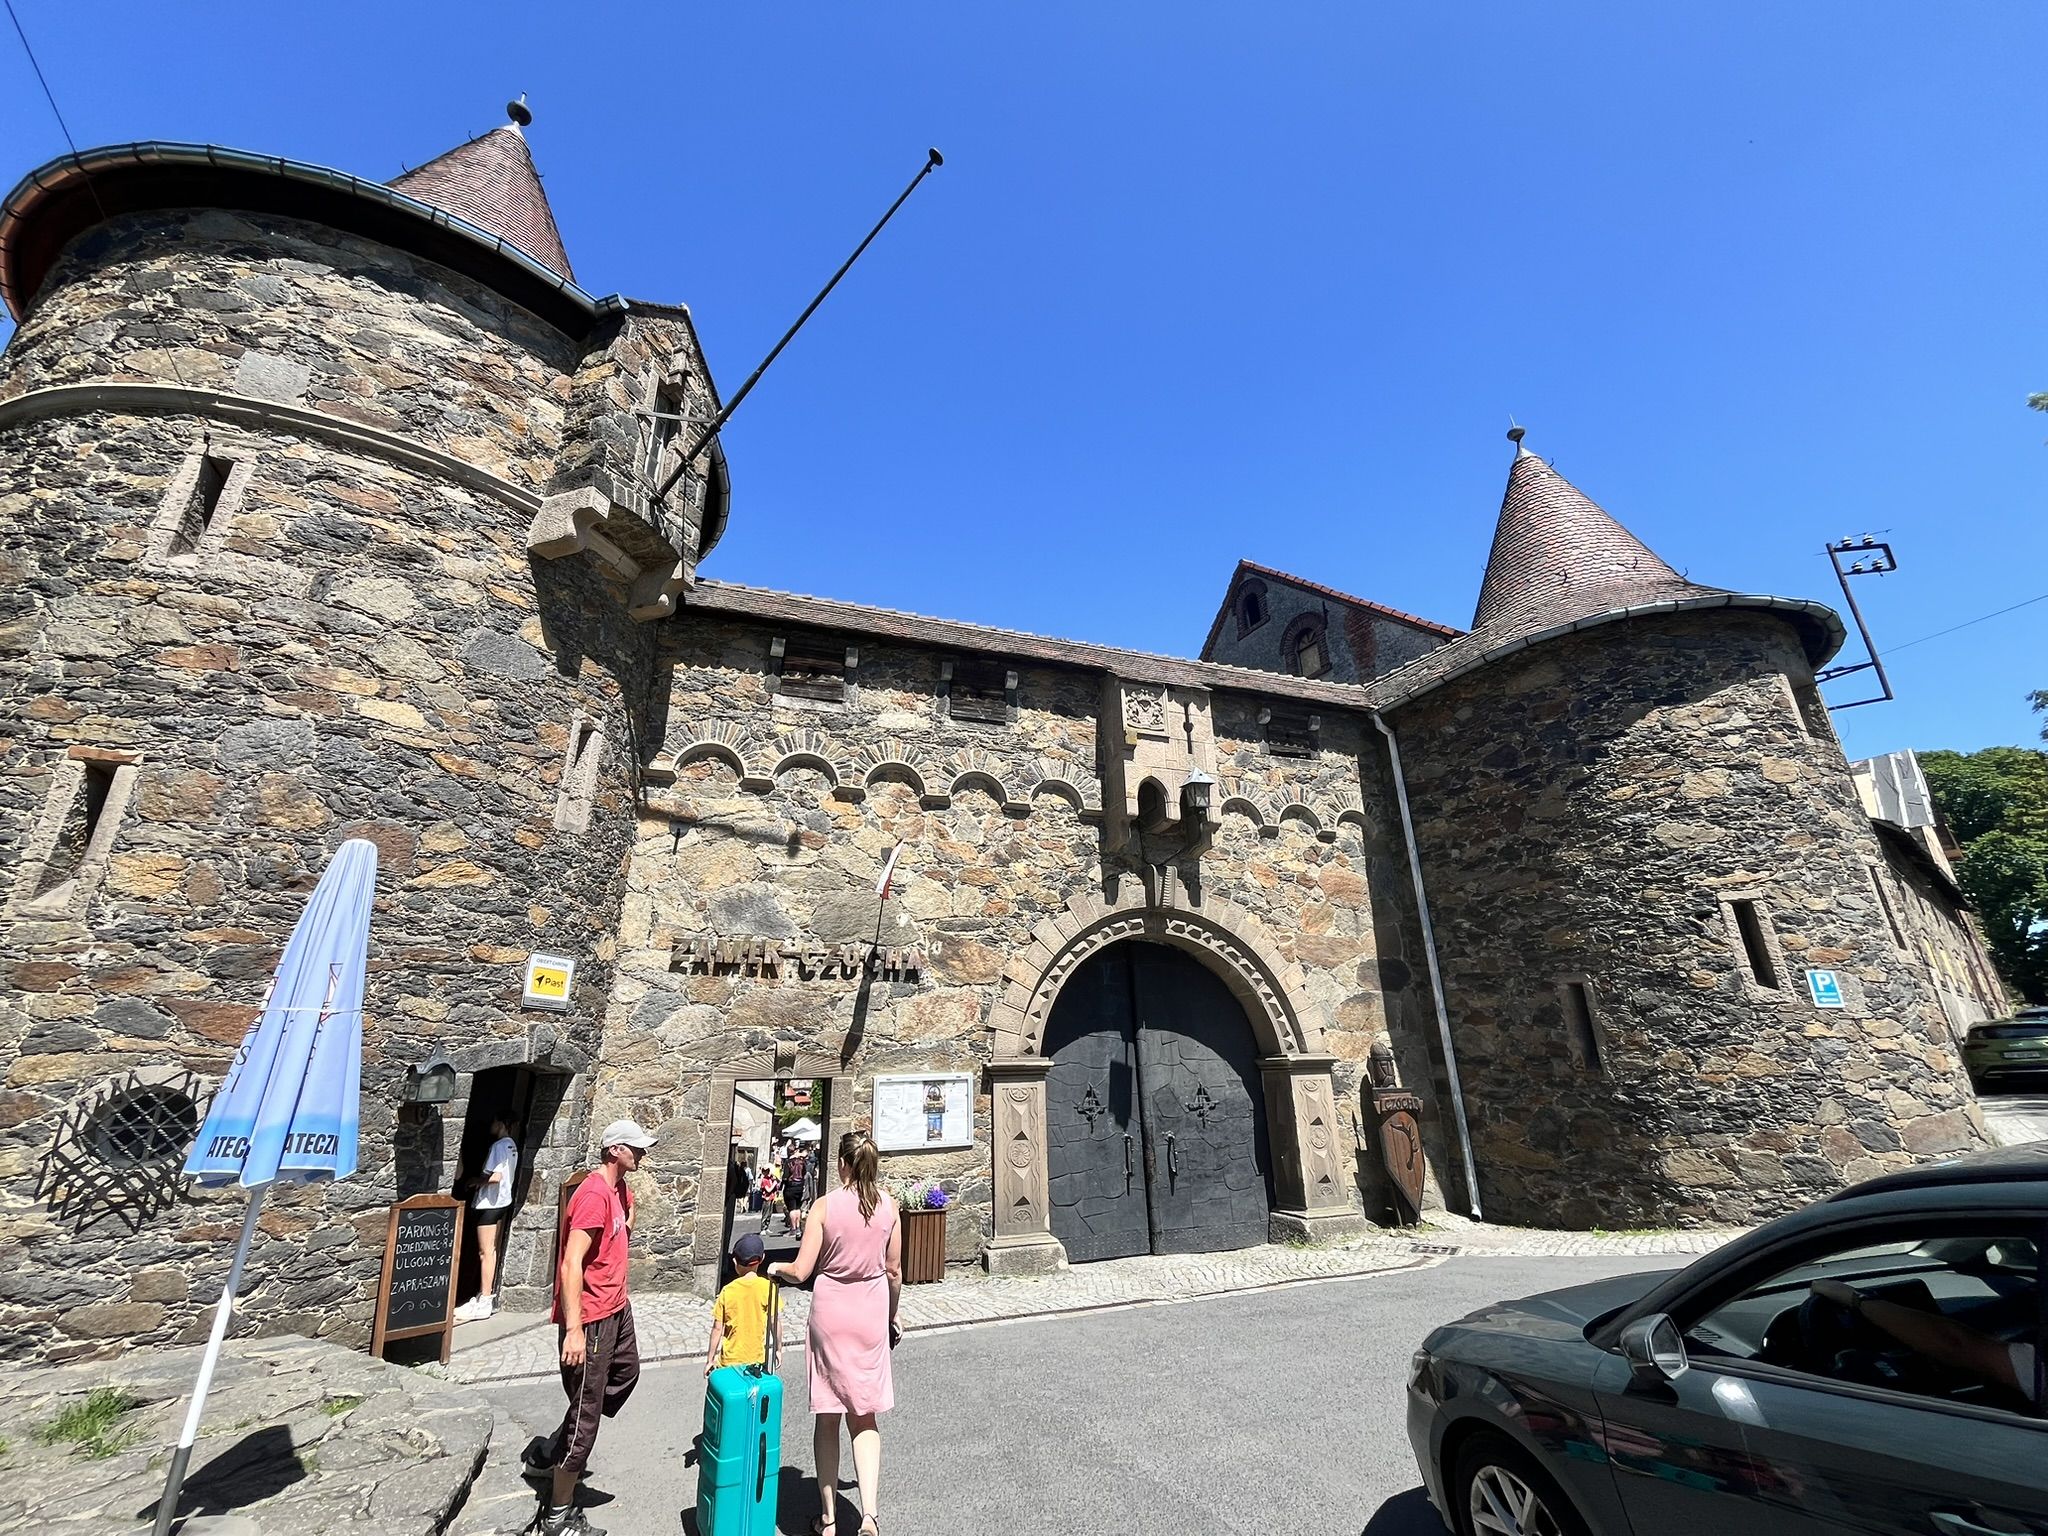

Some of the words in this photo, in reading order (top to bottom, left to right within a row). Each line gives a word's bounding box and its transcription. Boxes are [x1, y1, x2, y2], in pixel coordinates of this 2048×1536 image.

[670, 938, 784, 965] ZAMEK
[800, 942, 923, 970] CZOCHA
[1814, 974, 1832, 991] P
[390, 1275, 449, 1295] ZAPRASZAMY
